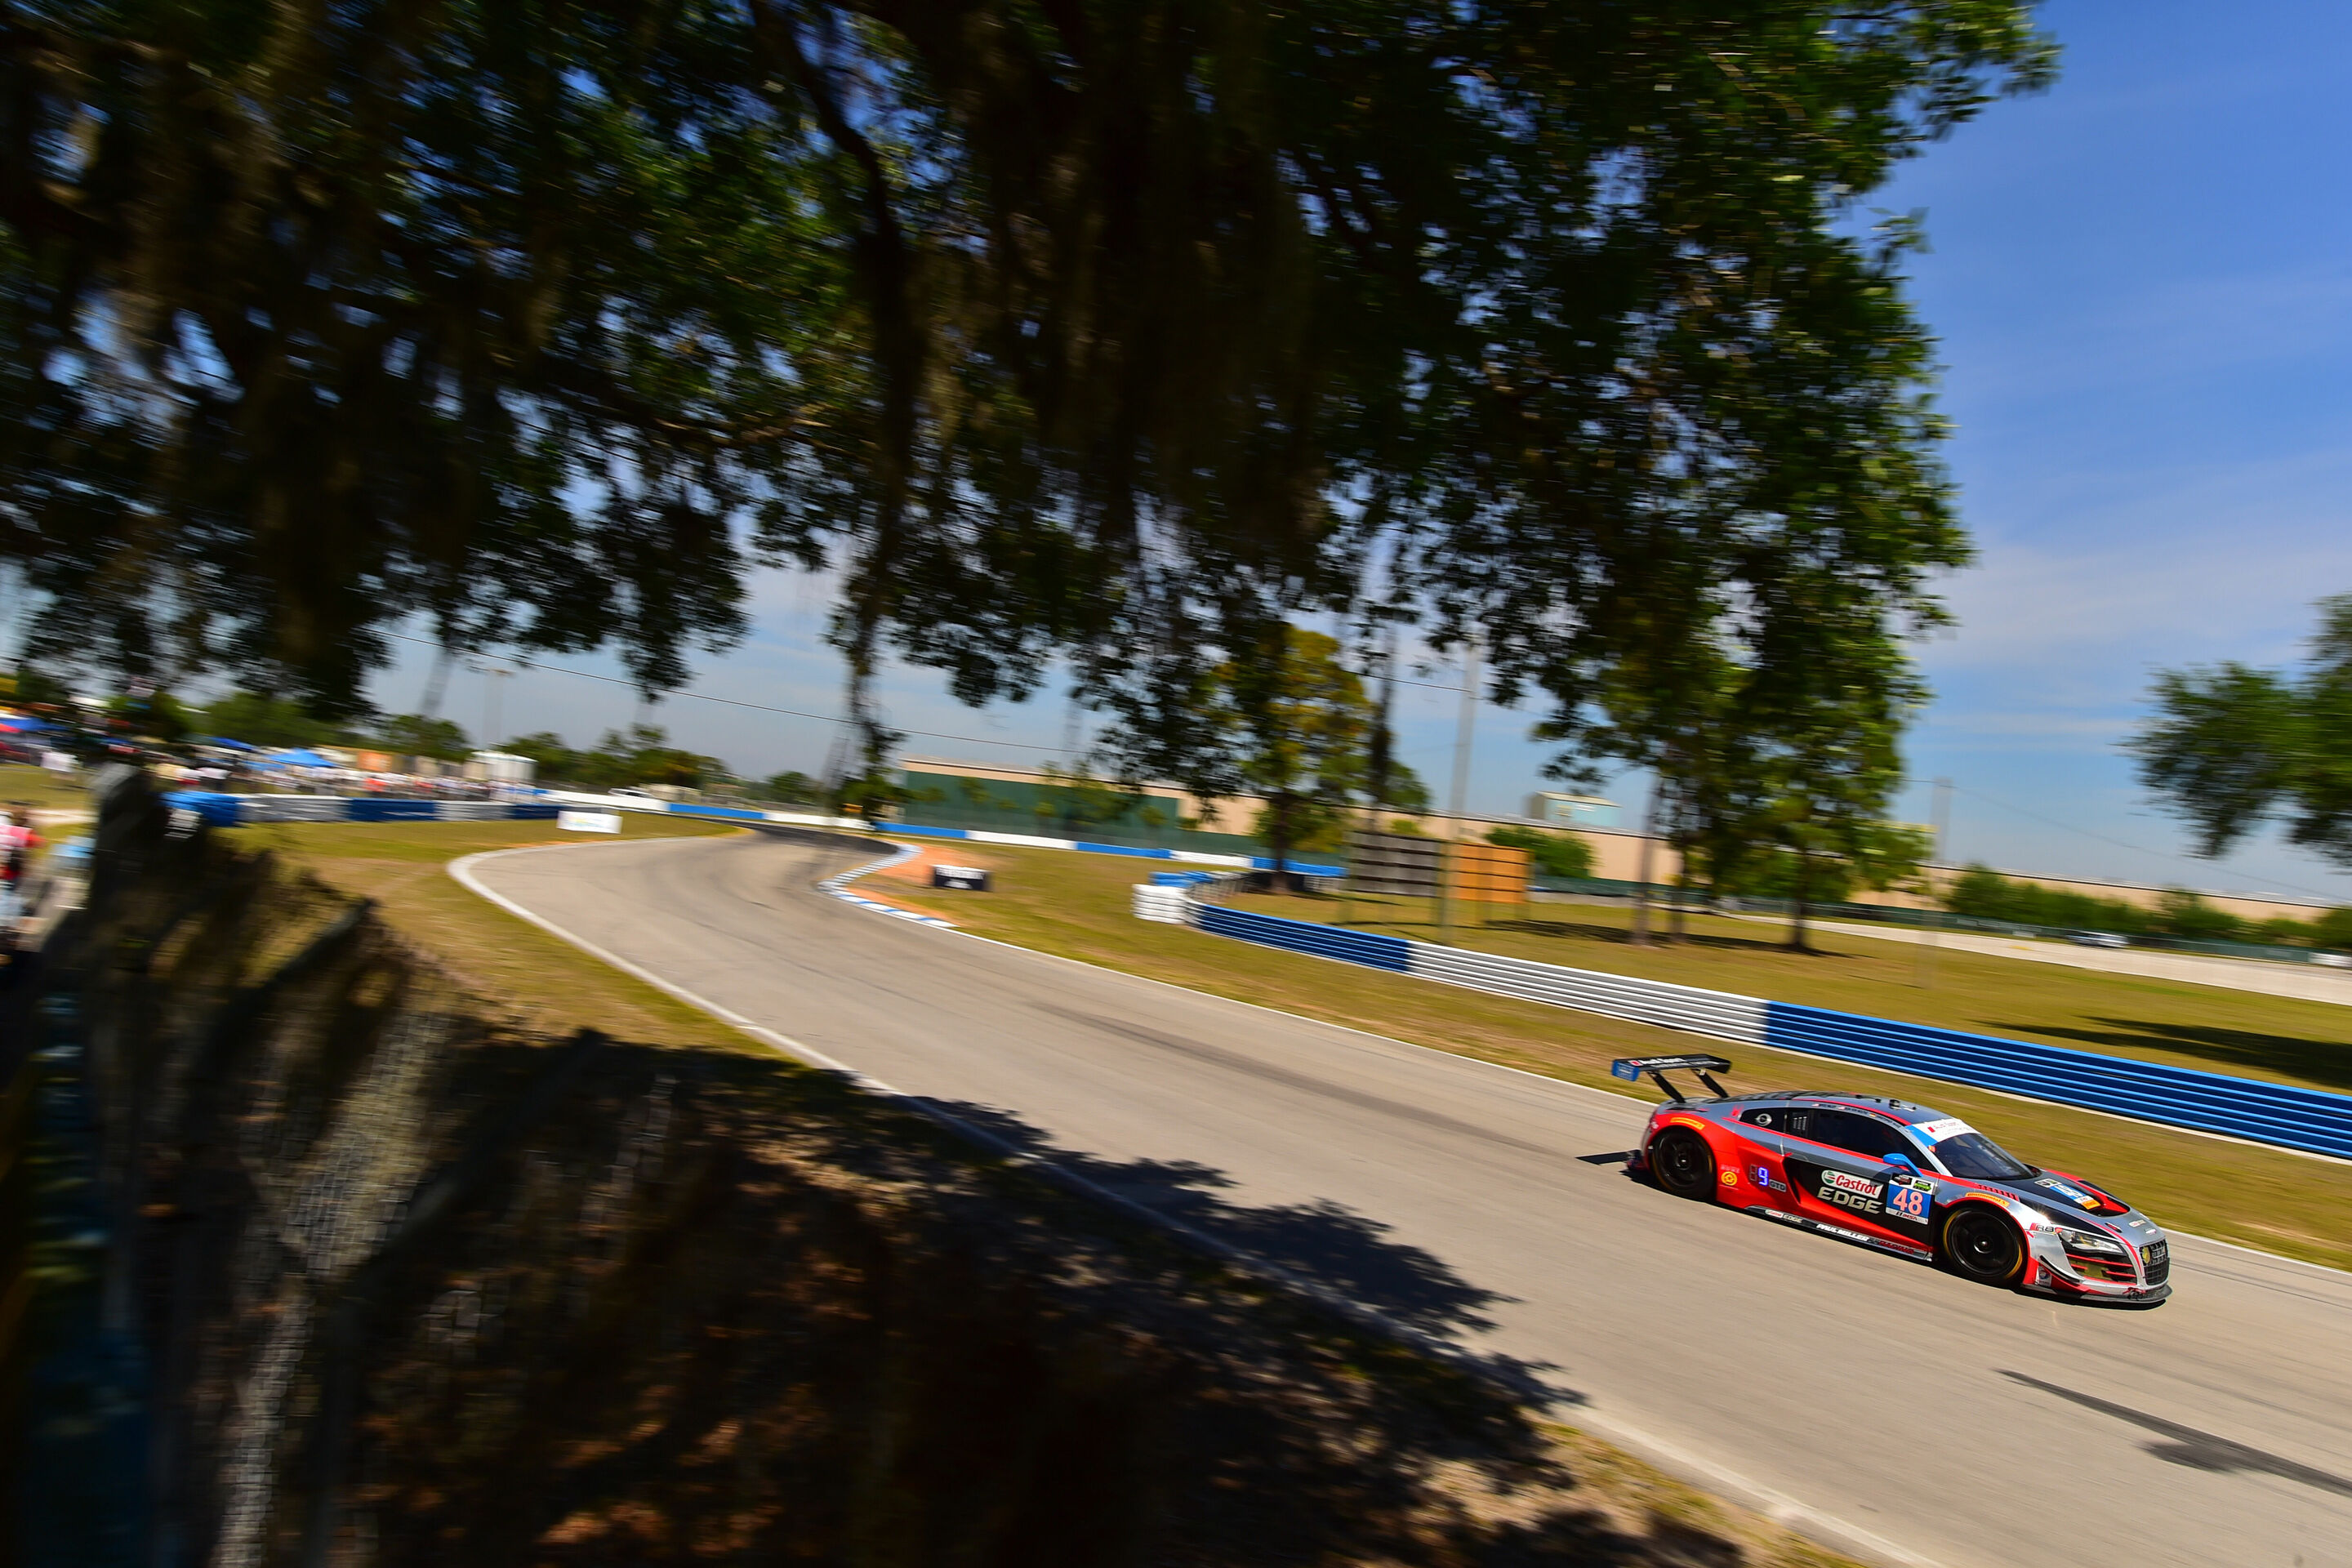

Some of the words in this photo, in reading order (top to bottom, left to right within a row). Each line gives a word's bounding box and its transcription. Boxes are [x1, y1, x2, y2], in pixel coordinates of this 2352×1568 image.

[1770, 1181, 1785, 1191] GTD
[1836, 1174, 1878, 1196] Castrol
[1817, 1187, 1884, 1214] EDGE
[1893, 1188, 1923, 1215] 48
[1783, 1214, 1803, 1223] EDGE
[2036, 1224, 2054, 1232] R8
[1815, 1223, 1838, 1233] PAUL
[1837, 1228, 1869, 1242] MILLER
[1878, 1241, 1915, 1254] RACING
